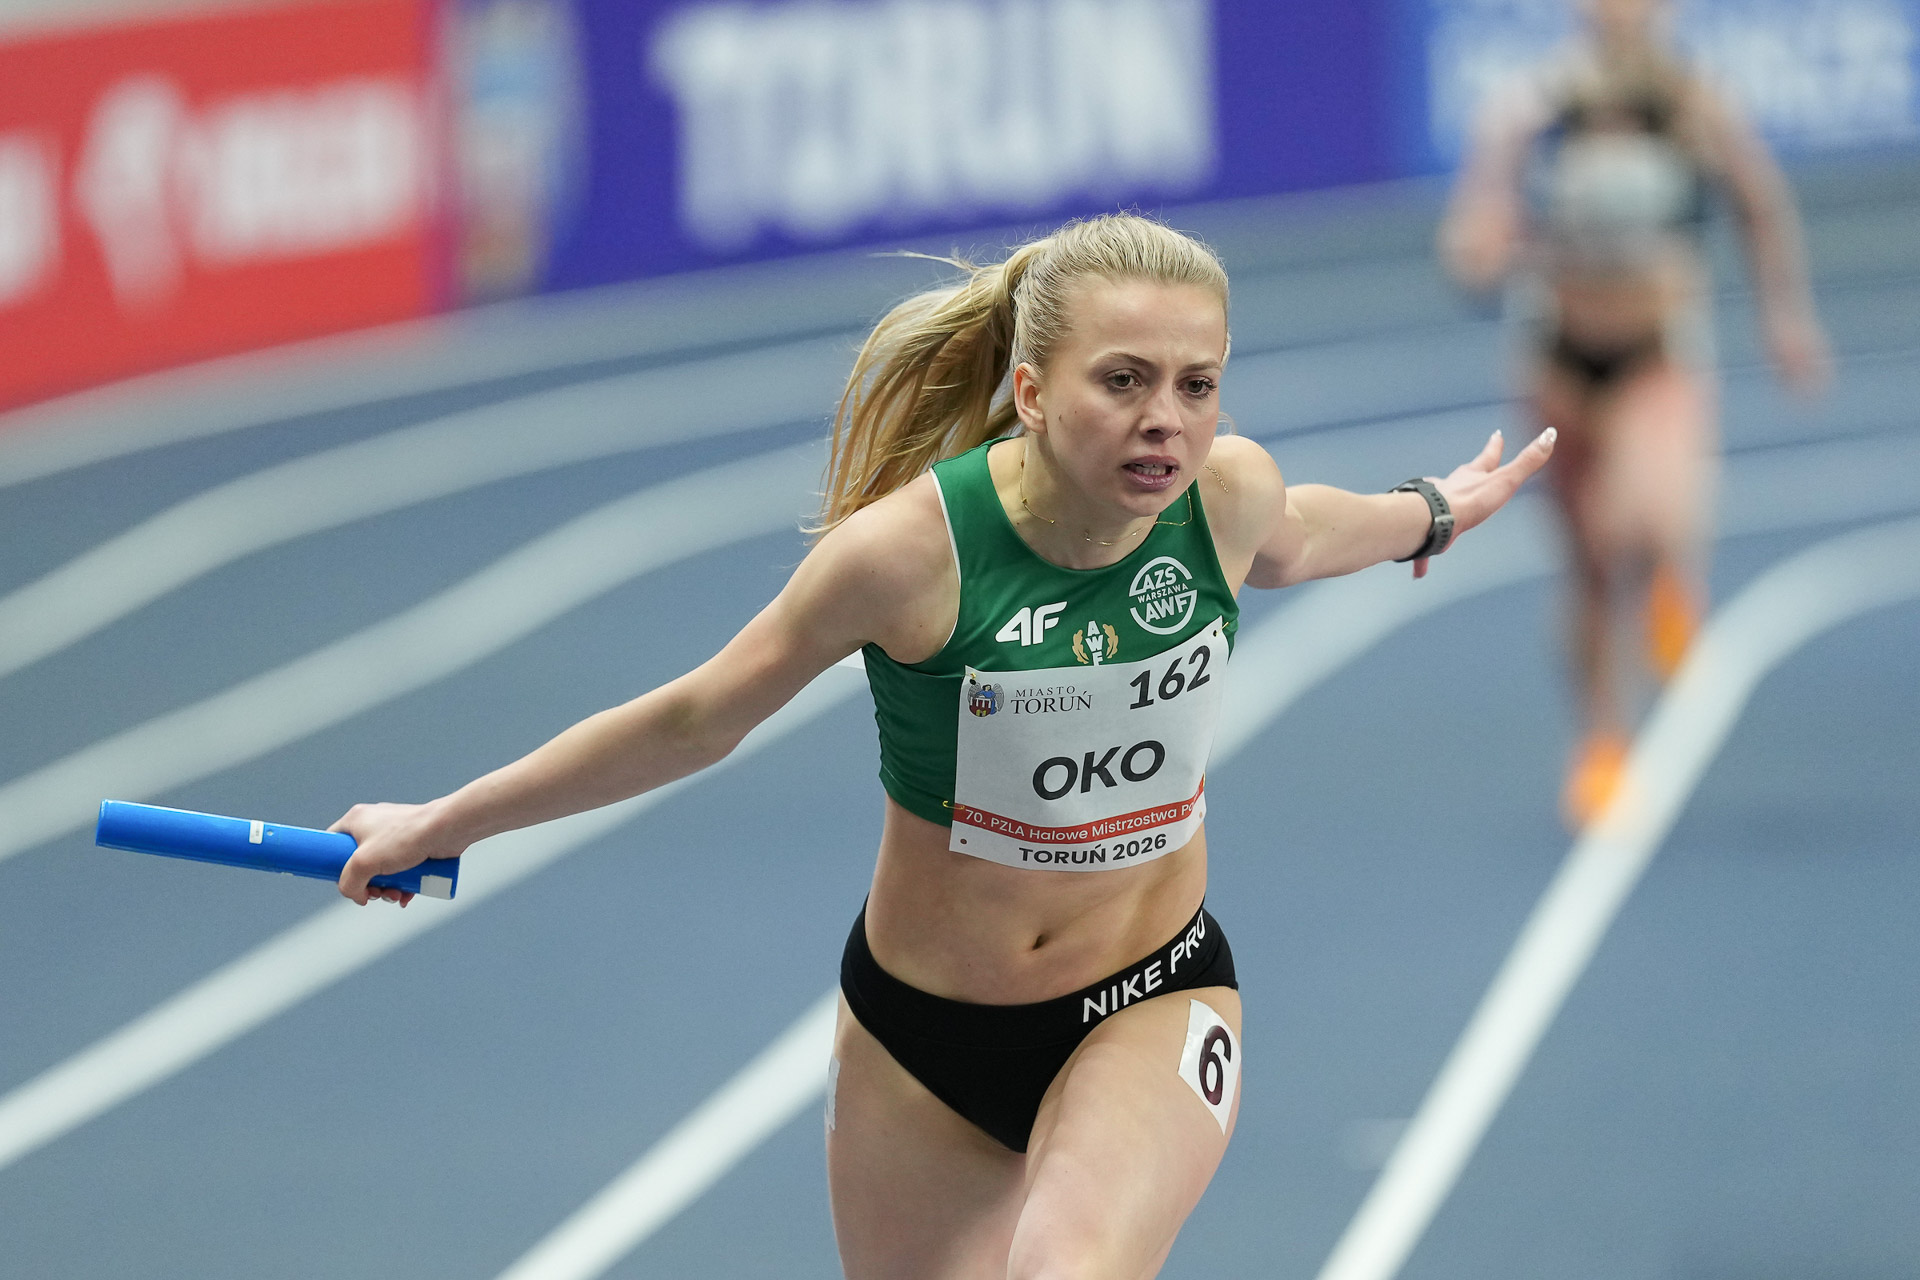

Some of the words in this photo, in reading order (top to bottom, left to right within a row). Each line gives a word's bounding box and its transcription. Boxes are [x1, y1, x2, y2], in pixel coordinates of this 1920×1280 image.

[1138, 582, 1189, 604] WARSZAWA
[1142, 565, 1177, 592] AZS
[995, 601, 1068, 647] 4F
[1145, 595, 1188, 623] AWF
[1015, 685, 1076, 698] MIASTO
[1129, 645, 1211, 710] 162
[1010, 690, 1093, 715] TORUŃ
[1032, 739, 1166, 801] OKO
[965, 808, 986, 825] 70.
[990, 817, 1025, 837] PZLA
[1029, 828, 1088, 841] Halowe
[1092, 808, 1177, 838] Mistrzostwa
[1018, 843, 1106, 864] TORUŃ
[1112, 833, 1167, 861] 2026
[1082, 960, 1163, 1024] NIKE
[1170, 909, 1206, 975] PRO
[1198, 1024, 1232, 1106] 6
